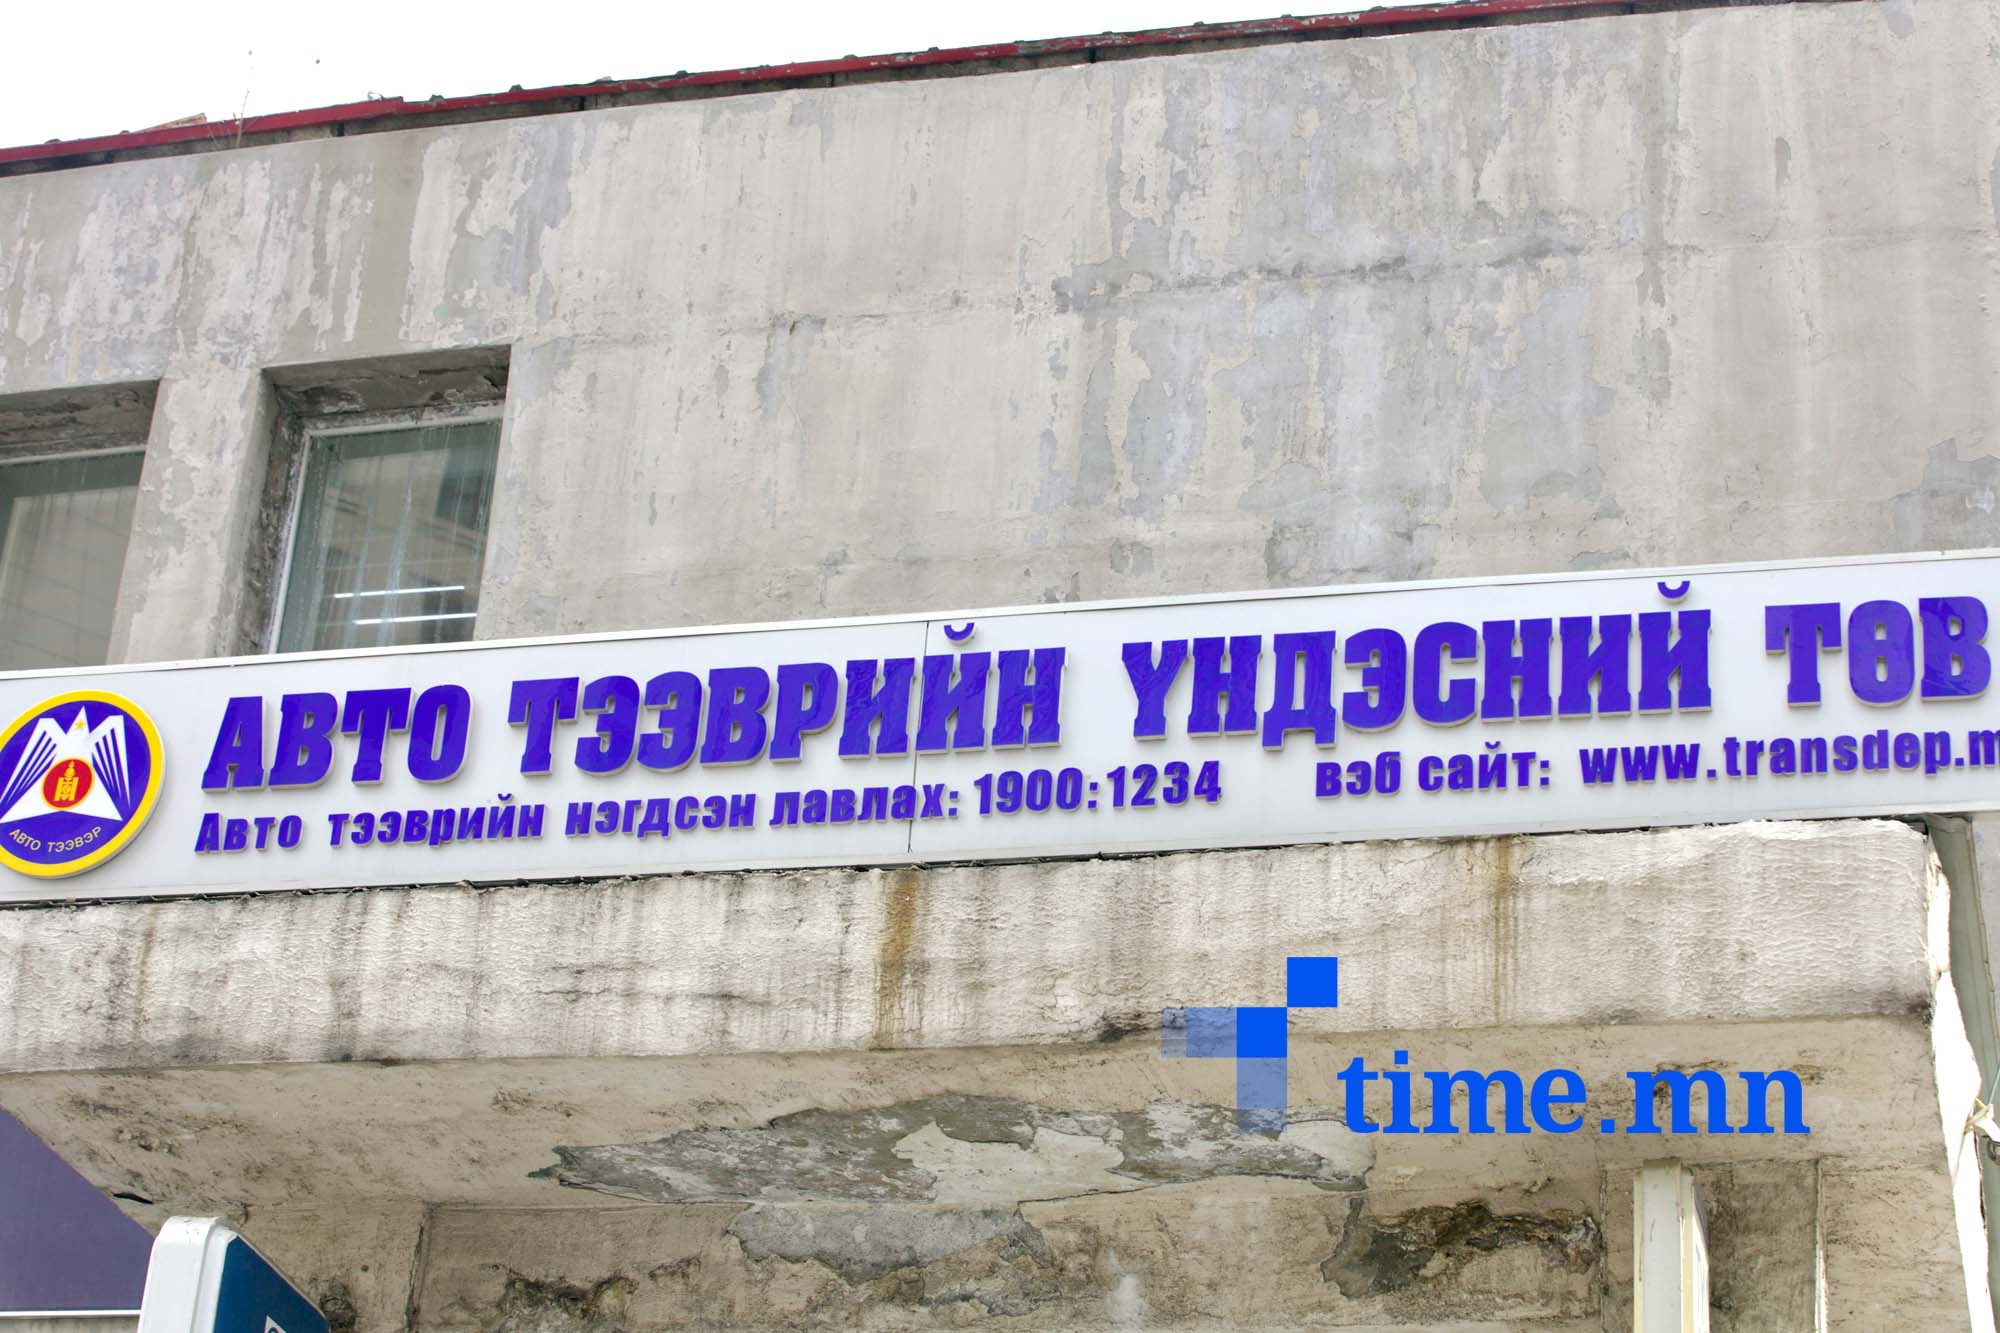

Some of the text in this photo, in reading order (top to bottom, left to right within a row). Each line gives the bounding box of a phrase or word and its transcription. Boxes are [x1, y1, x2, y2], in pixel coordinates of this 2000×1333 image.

[201, 580, 1992, 791] АВТО ТЭЭВРИЙН ҮНДЭСНИЙ ТӨВ
[1315, 741, 1550, 798] вэб сайт:
[1578, 728, 2000, 785] www.transdep.m
[194, 760, 1222, 853] Авто тээврийн нэгдсэн лавлах: 1900:1234
[9, 826, 101, 852] АВТО ТЭЭВЭР
